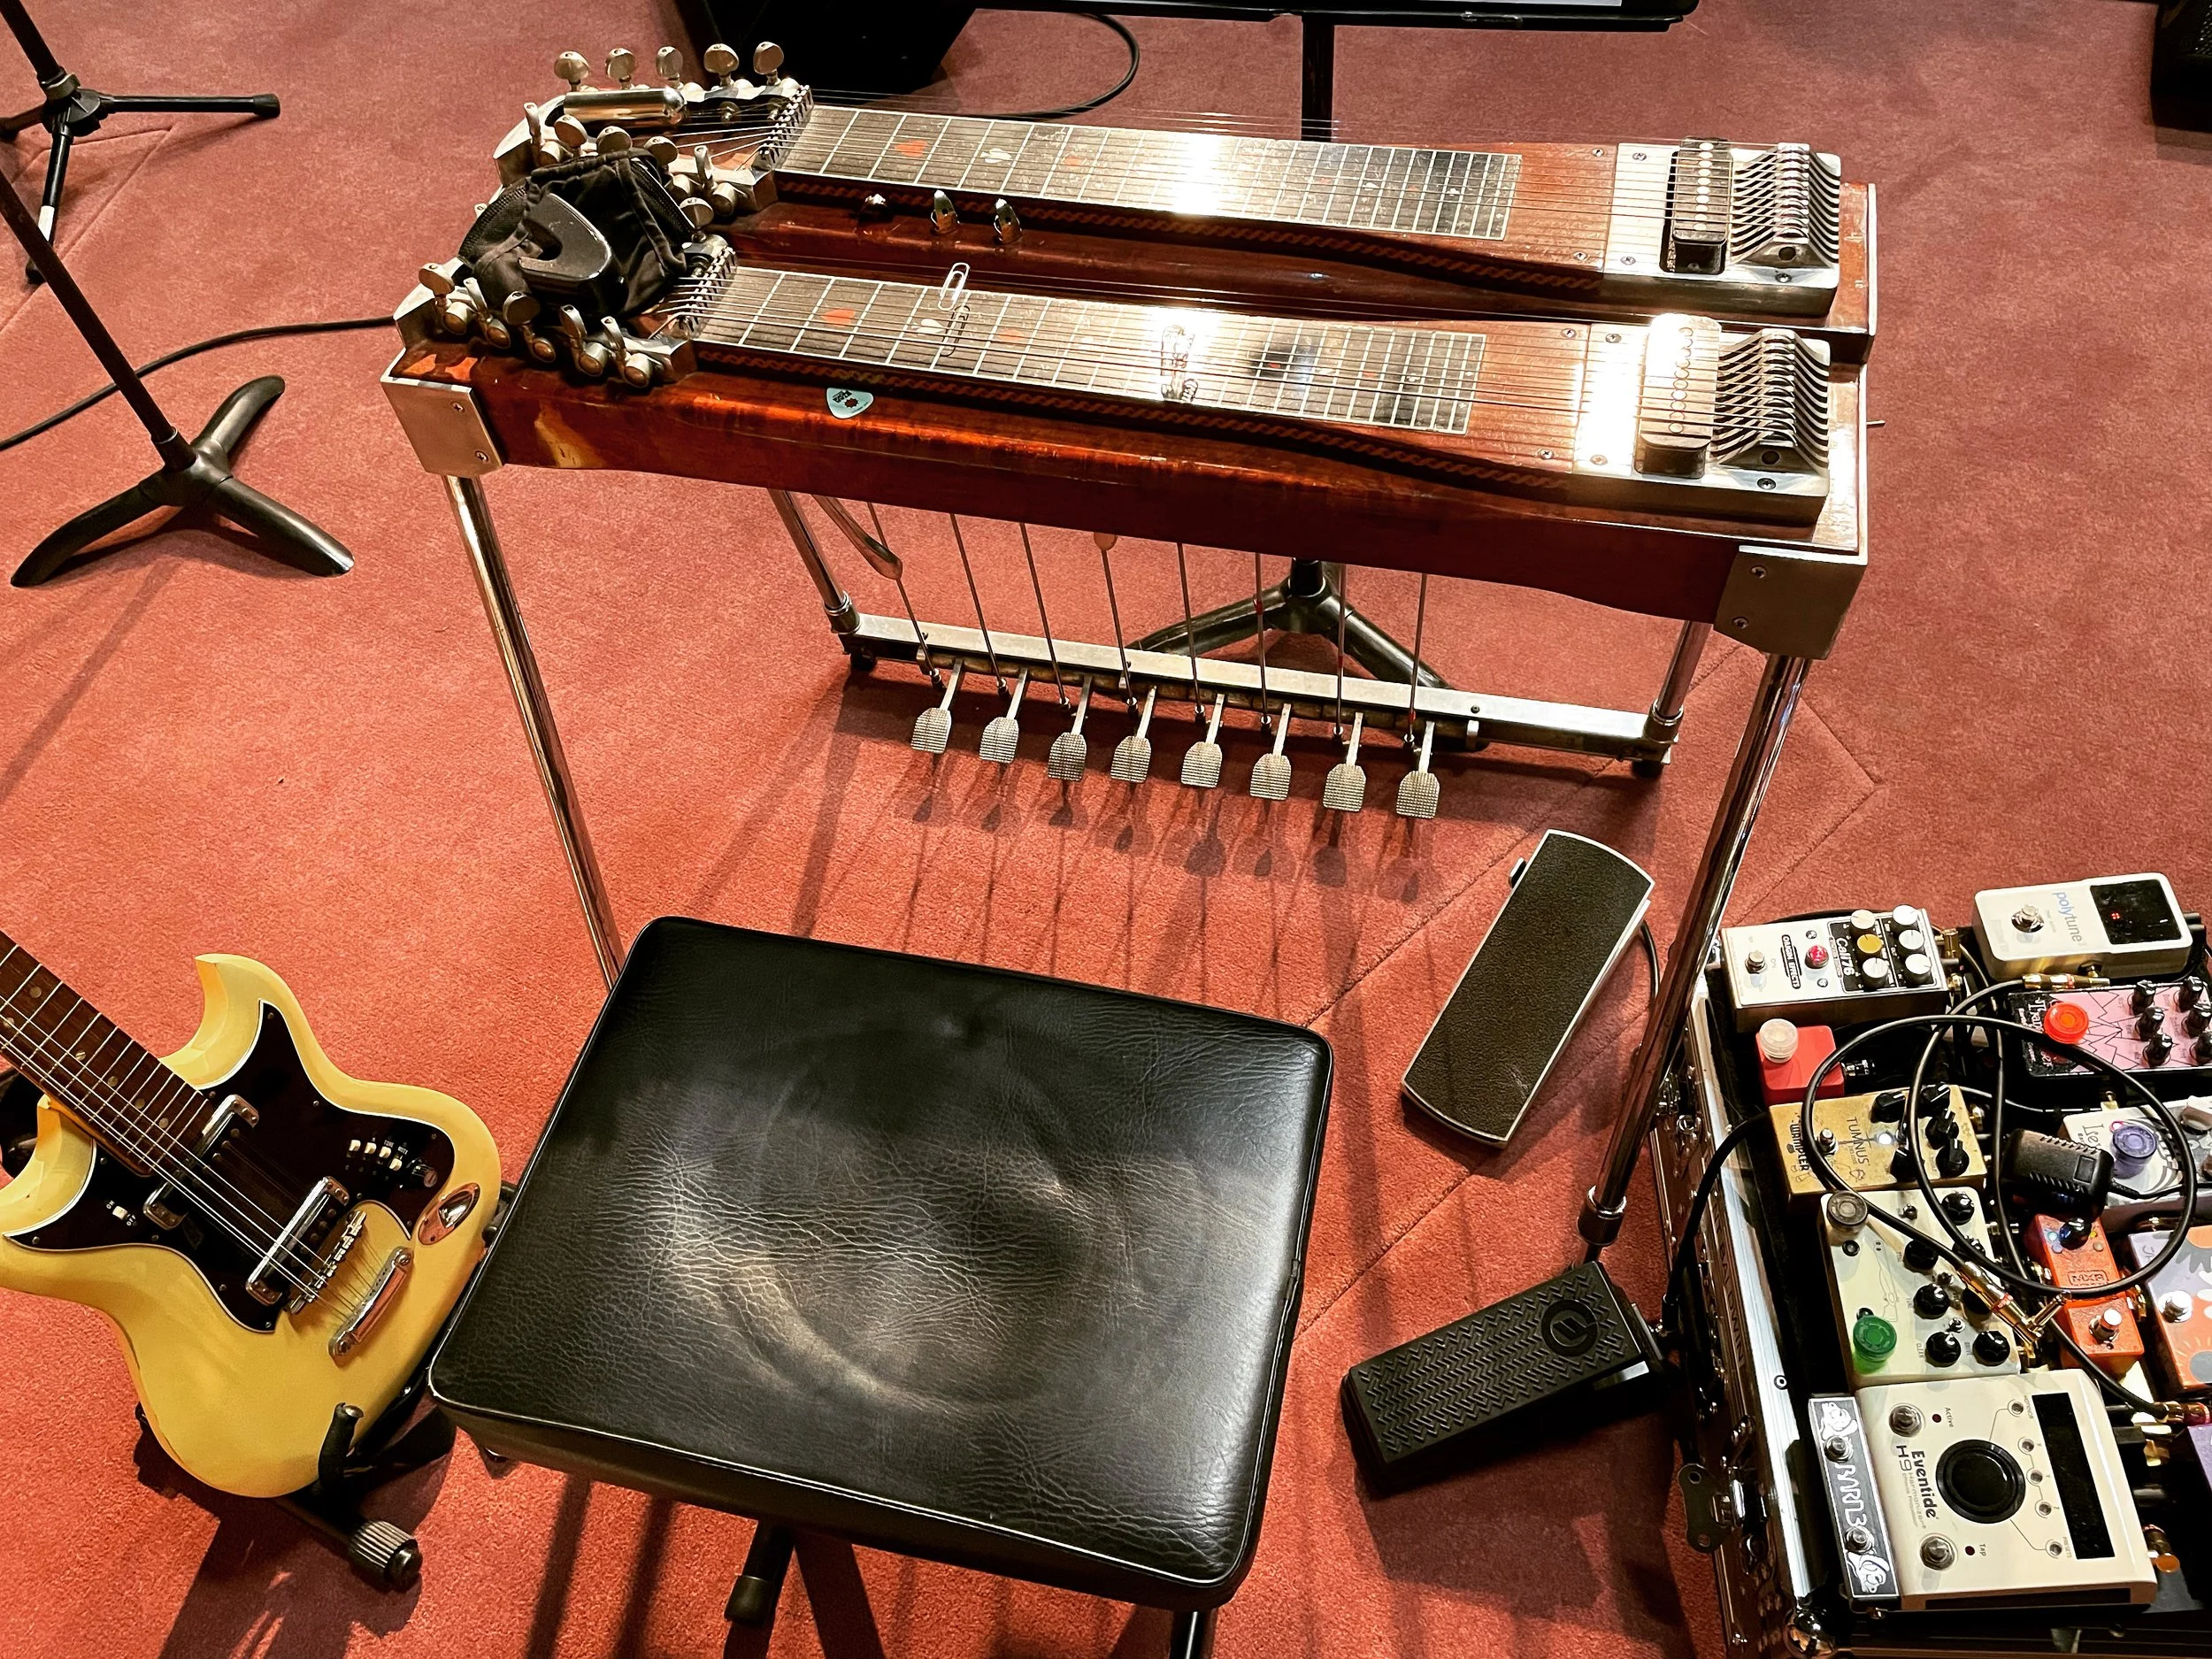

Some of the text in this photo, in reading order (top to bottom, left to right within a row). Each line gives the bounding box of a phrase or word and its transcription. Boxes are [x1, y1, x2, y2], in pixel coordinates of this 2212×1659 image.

[2052, 892, 2083, 942] polytune
[1782, 935, 1801, 988] ORIGIN EFFECTS
[1836, 937, 1855, 976] Cali76
[1790, 1124, 1810, 1171] WAMPLER
[1847, 1117, 1870, 1164] TUMNUS
[106, 1200, 115, 1210] ON
[127, 1214, 136, 1226] OFF
[2071, 1272, 2105, 1283] MXR
[1719, 1242, 1746, 1371] BALDWIN
[1945, 1407, 1955, 1428] Active
[1896, 1445, 1912, 1471] H9
[1911, 1450, 1938, 1519] Eventide
[2062, 1536, 2072, 1558] PRESETS
